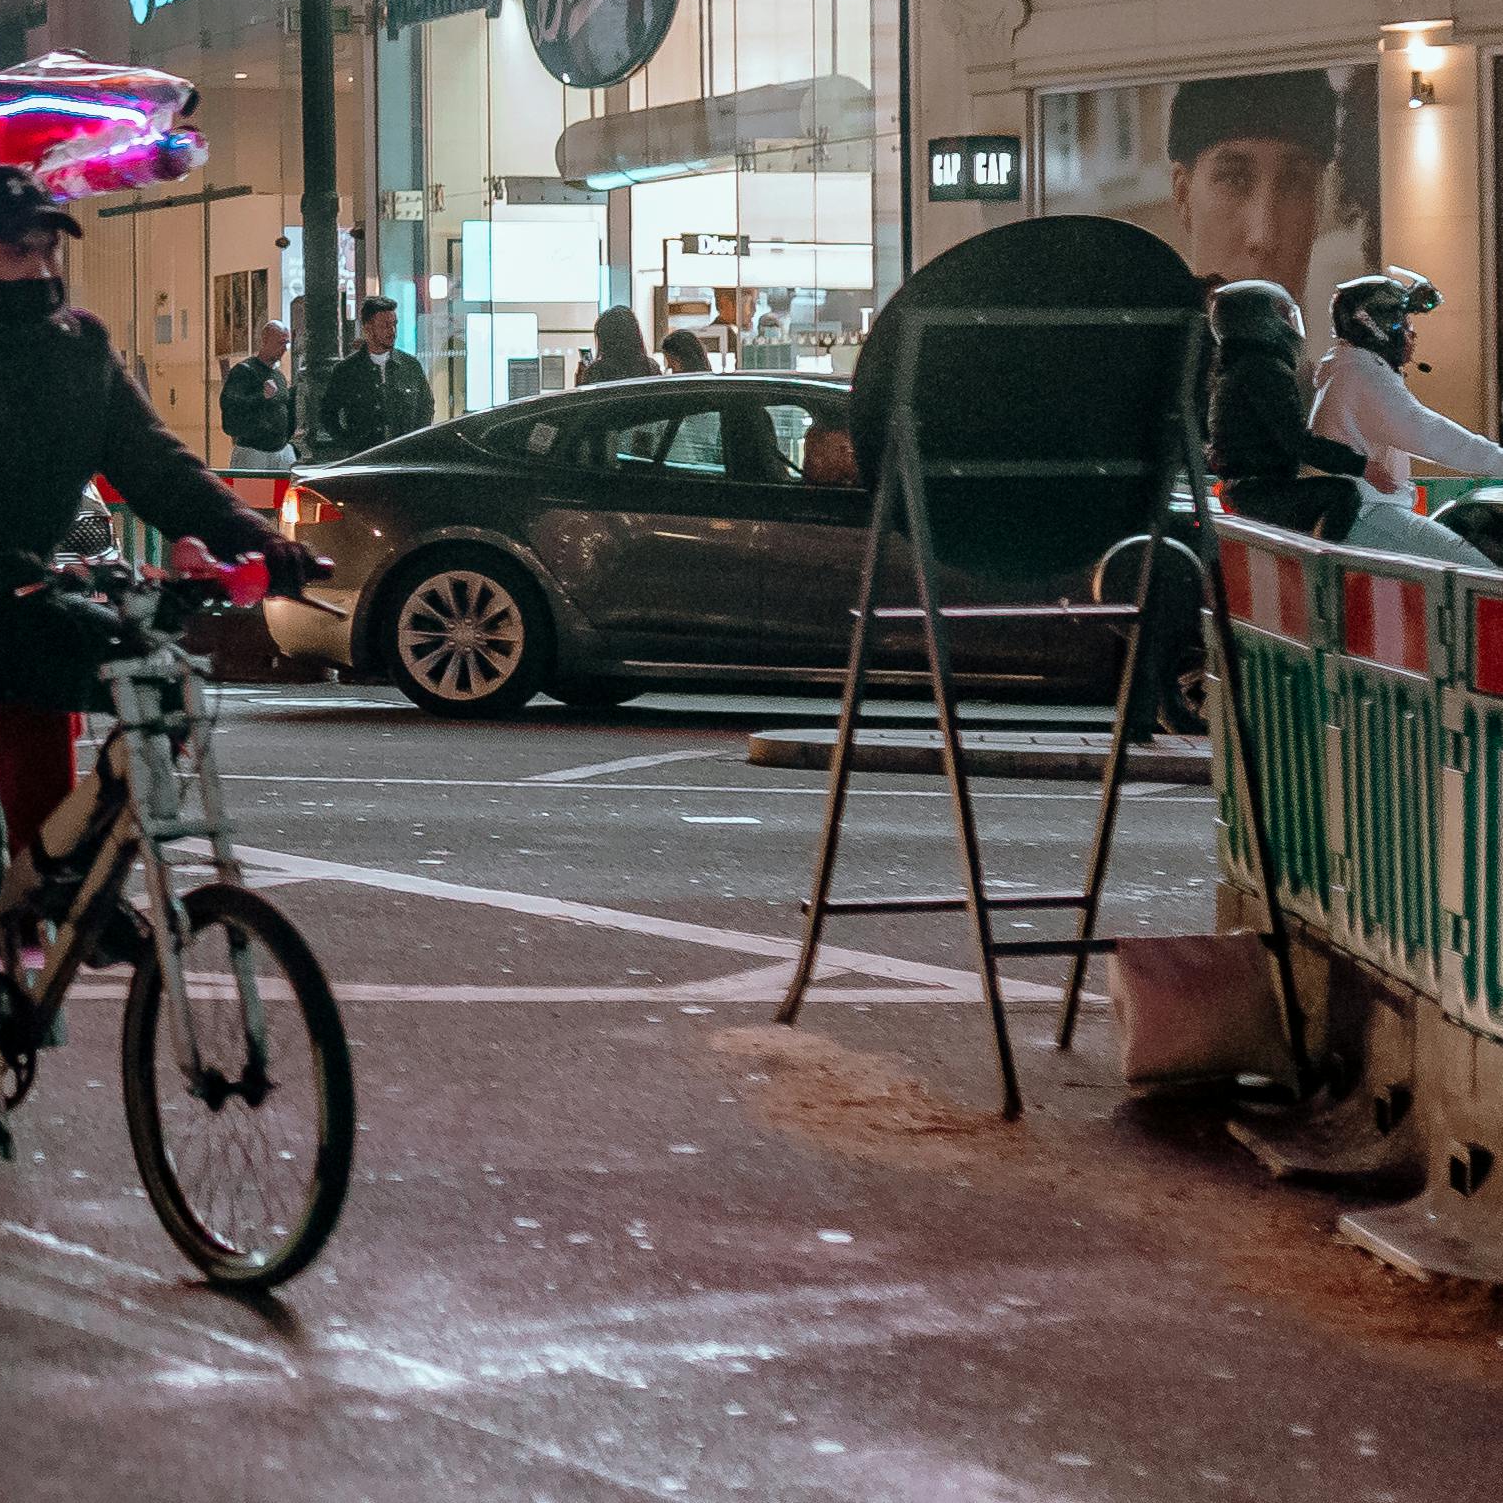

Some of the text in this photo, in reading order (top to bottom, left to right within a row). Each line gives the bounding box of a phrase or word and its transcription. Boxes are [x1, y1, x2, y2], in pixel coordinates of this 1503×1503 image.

[933, 152, 962, 186] GAP
[974, 152, 1011, 185] GAP
[697, 234, 738, 255] Dior
